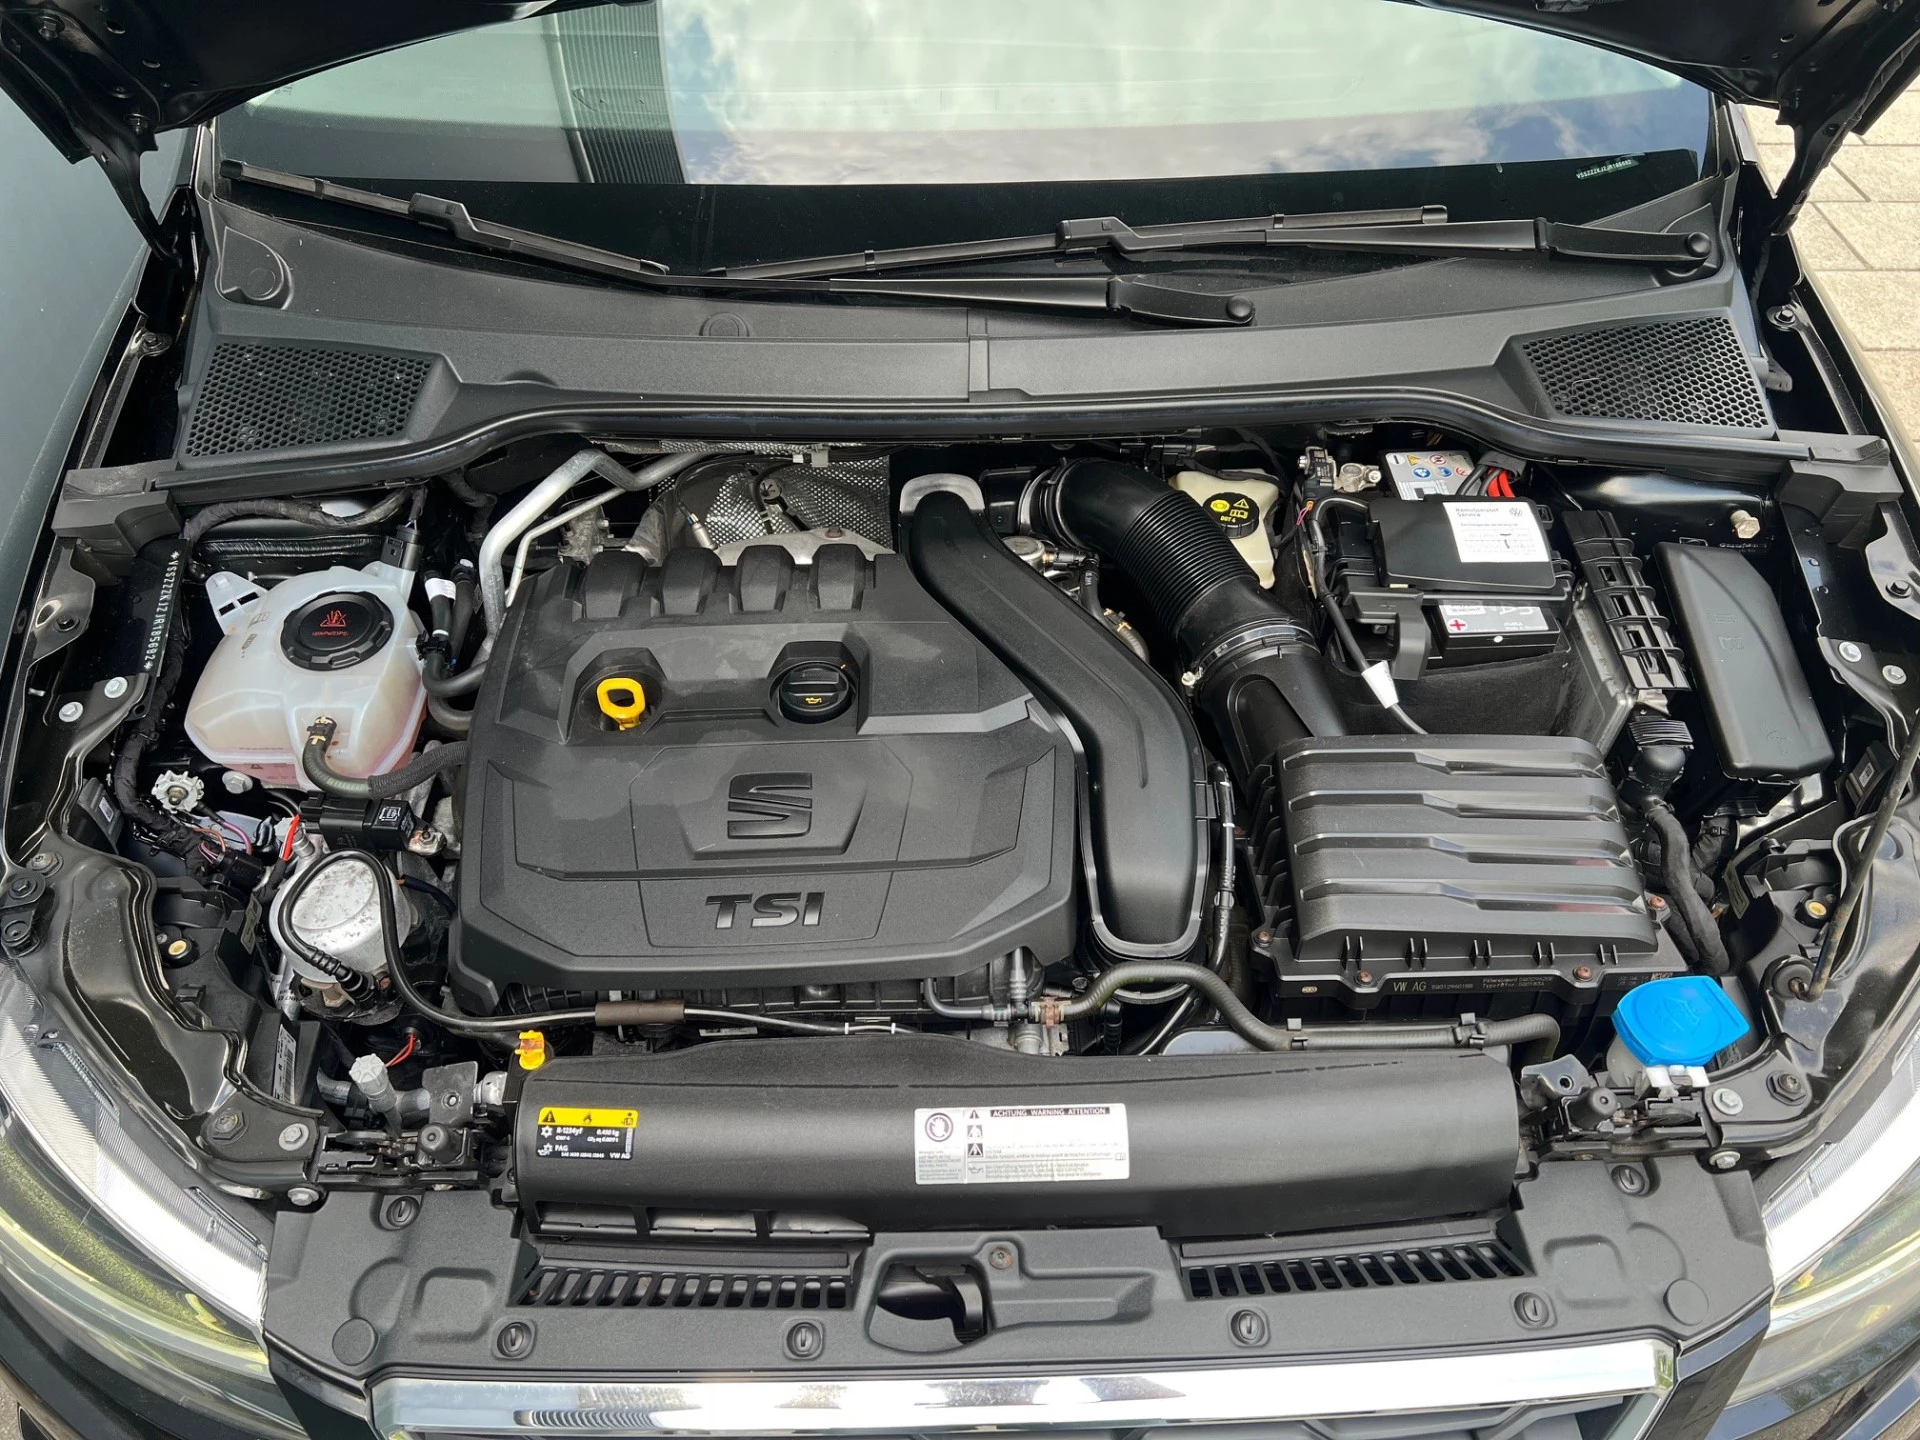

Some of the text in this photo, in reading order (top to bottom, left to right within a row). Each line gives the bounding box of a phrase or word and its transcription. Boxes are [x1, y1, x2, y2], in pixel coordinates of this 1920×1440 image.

[705, 891, 826, 930] TSI
[1393, 981, 1408, 992] VW
[1412, 981, 1427, 992] AG
[993, 1107, 1106, 1117] ACHTUNG WARNING ATTENTION
[556, 1127, 583, 1136] R-1234yf
[554, 1144, 569, 1152] PAG
